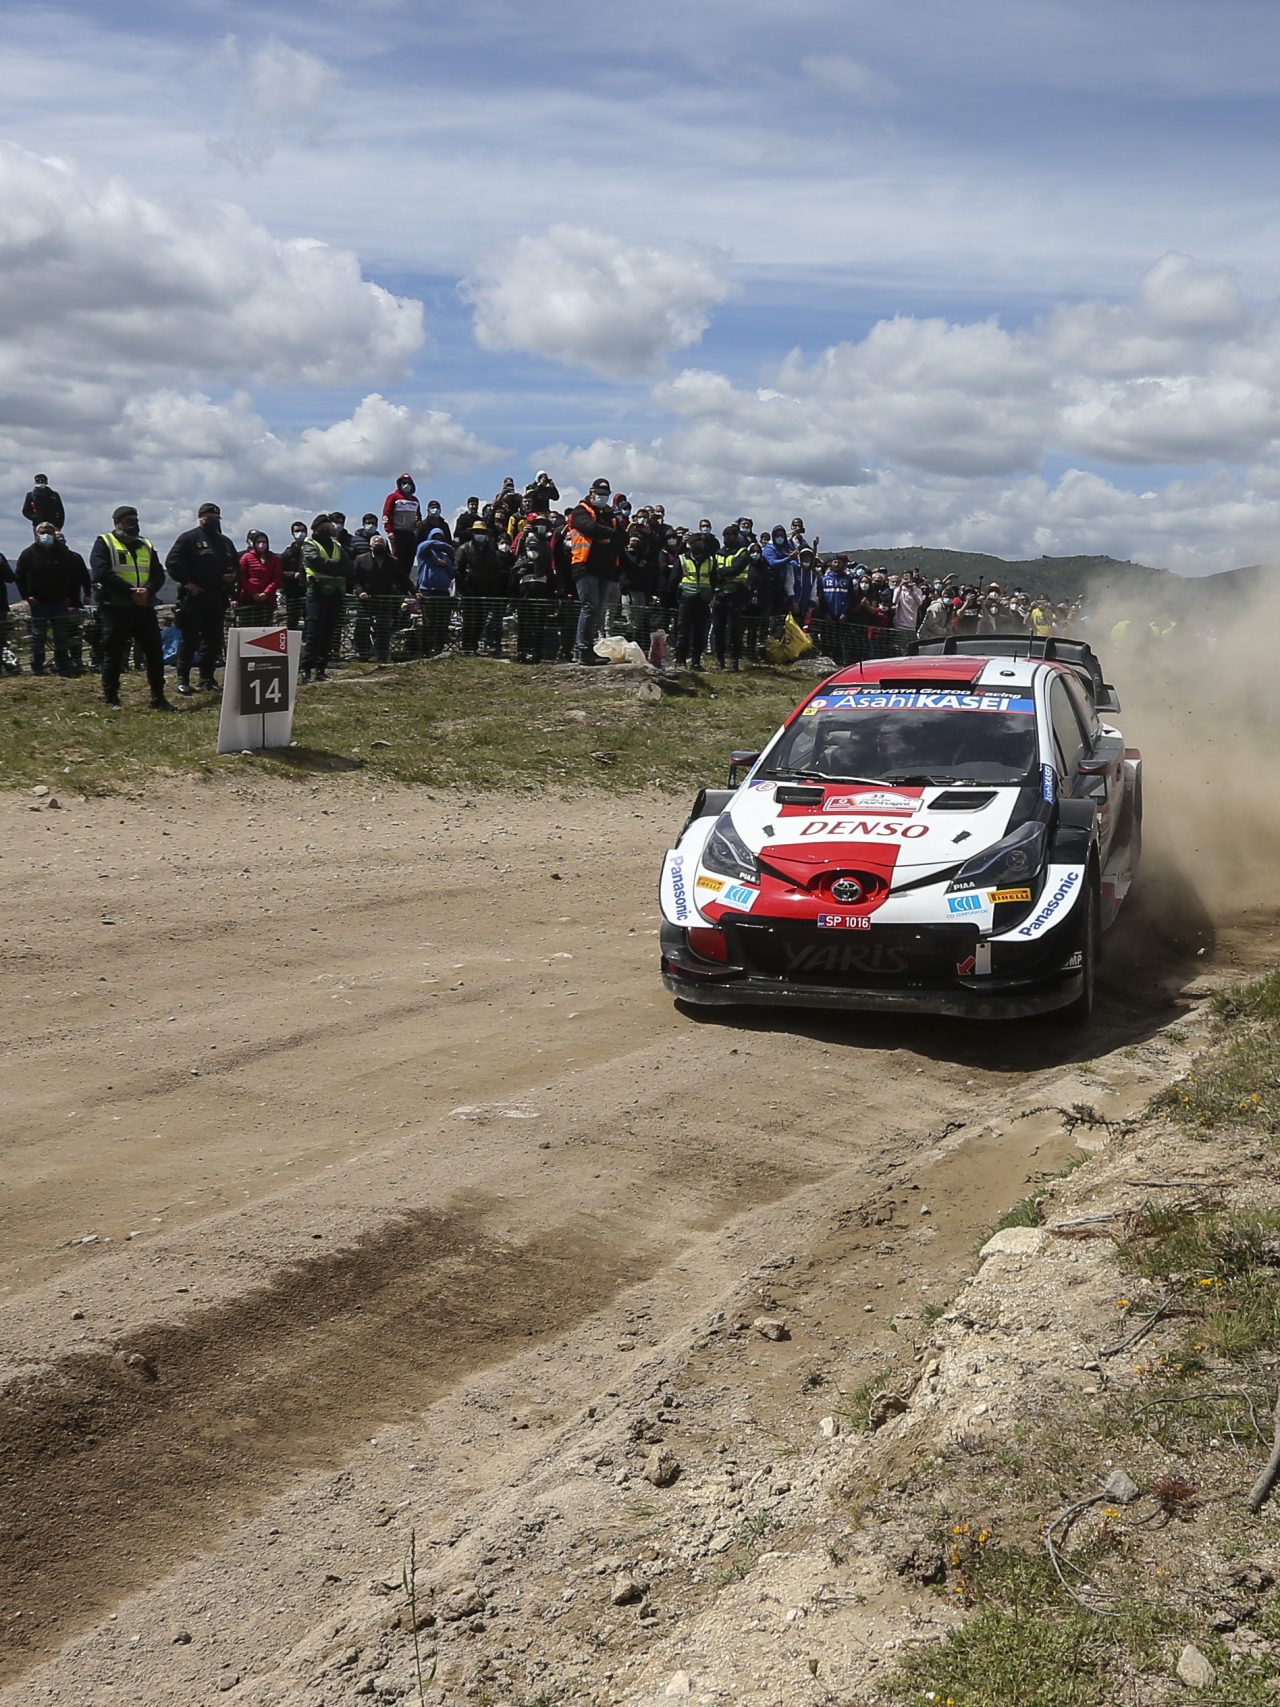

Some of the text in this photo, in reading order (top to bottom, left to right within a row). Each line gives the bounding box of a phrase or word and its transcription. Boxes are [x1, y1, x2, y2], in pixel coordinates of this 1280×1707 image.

[250, 678, 282, 705] 14
[800, 821, 930, 839] DENSO
[739, 872, 756, 883] PIAA
[953, 882, 976, 890] PIAA
[670, 855, 691, 921] Panasonic
[1018, 871, 1079, 936] Panasonic
[826, 916, 869, 928] SP 1016
